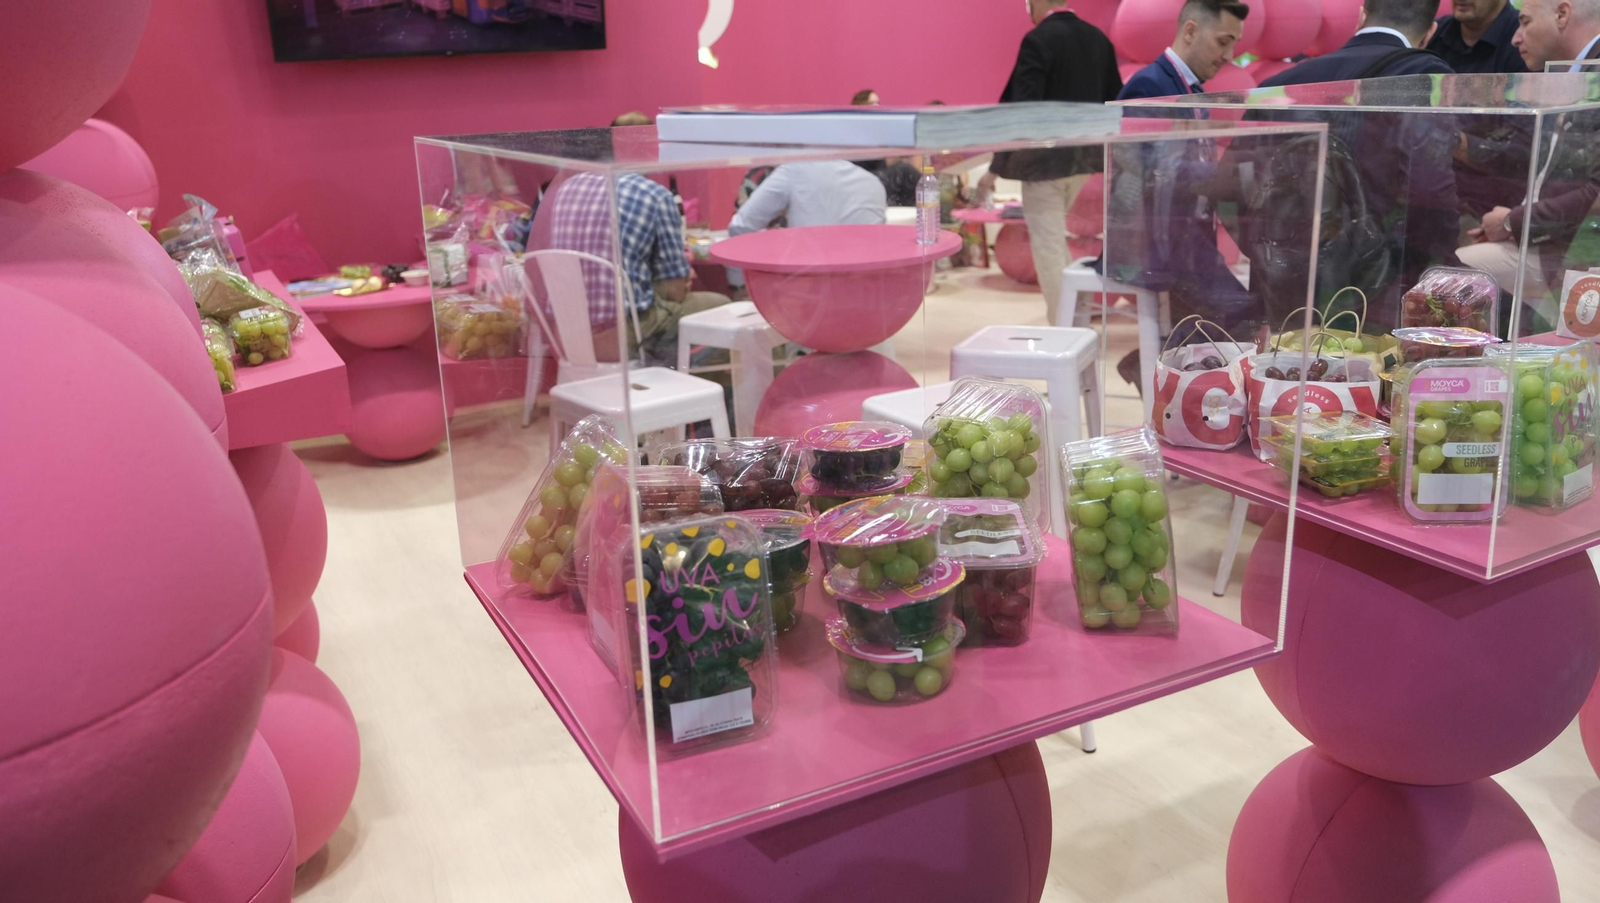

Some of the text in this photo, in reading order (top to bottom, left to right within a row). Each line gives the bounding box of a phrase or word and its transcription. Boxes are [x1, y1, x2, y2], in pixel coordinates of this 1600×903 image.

[1581, 293, 1595, 321] MOYCA
[1430, 380, 1465, 388] MOYCA
[1563, 374, 1587, 396] UVA
[1287, 390, 1330, 404] sedless
[1456, 444, 1497, 455] SEEDLESS
[660, 562, 720, 595] UVA
[636, 588, 759, 659] sin
